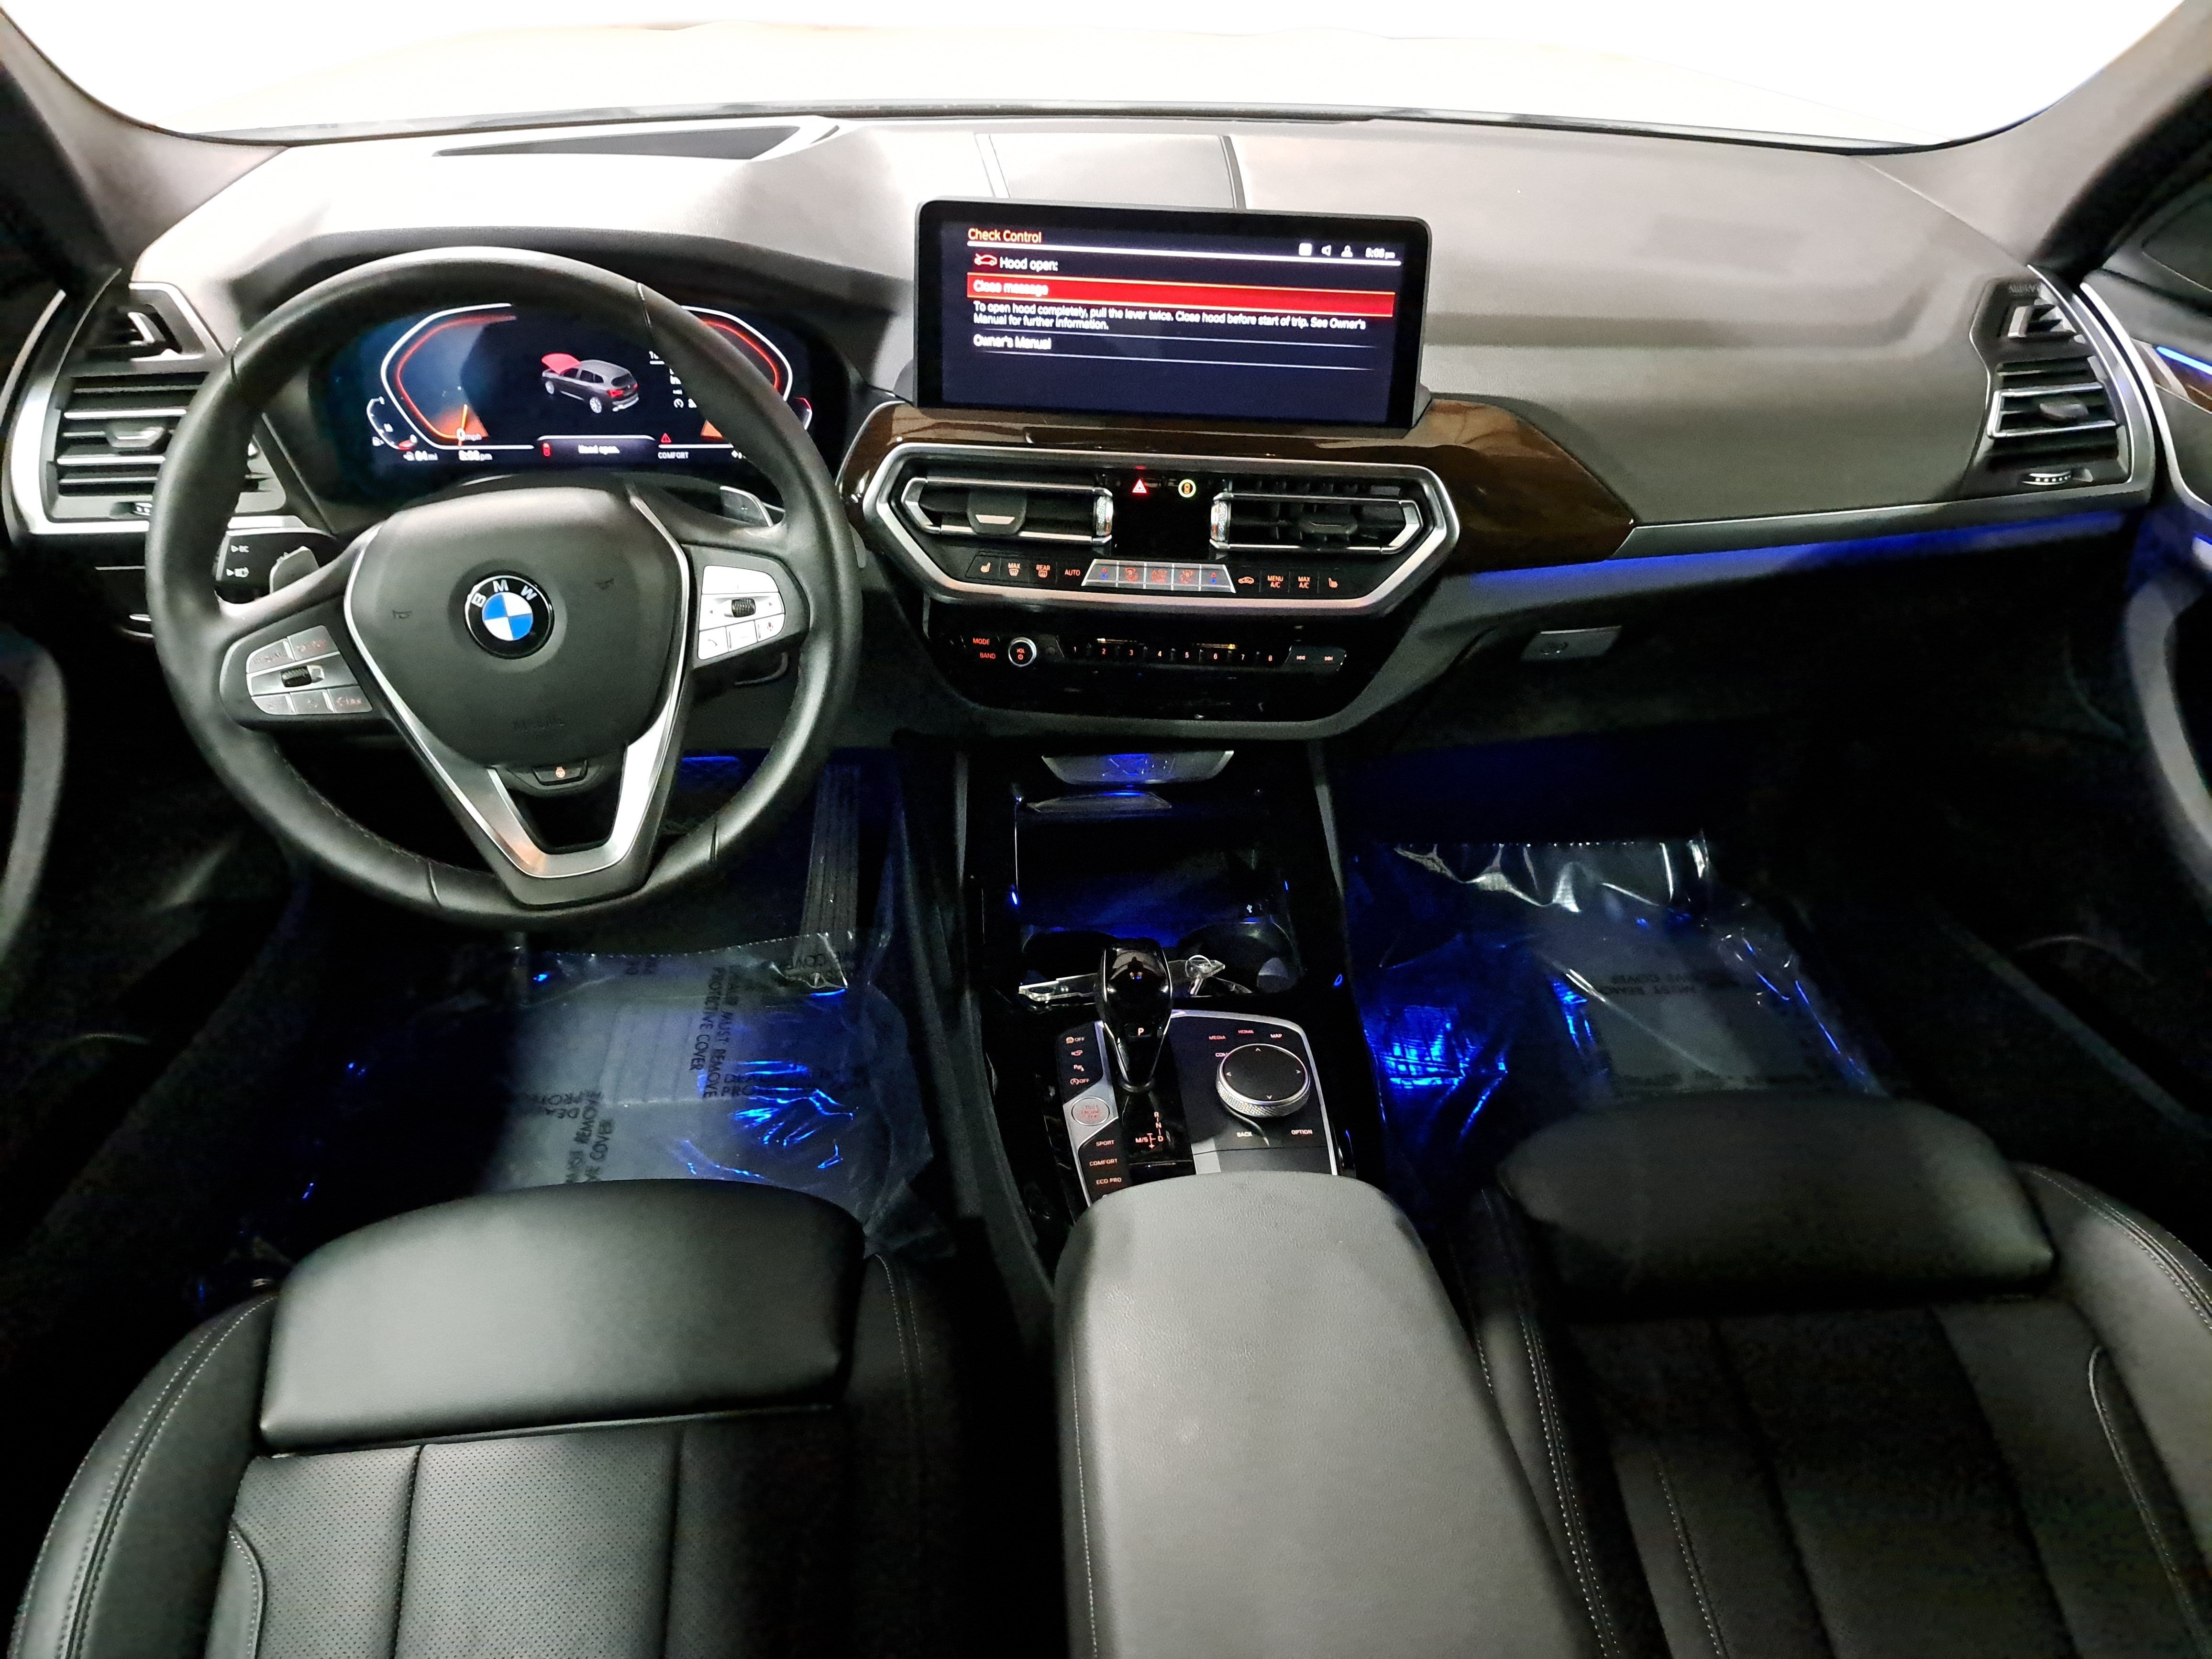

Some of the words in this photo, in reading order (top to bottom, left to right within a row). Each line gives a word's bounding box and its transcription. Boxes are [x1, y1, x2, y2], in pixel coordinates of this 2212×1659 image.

[968, 228, 1001, 241] Check
[1003, 230, 1041, 243] Control
[1000, 256, 1028, 269] Hood
[1029, 260, 1058, 272] open:
[973, 279, 1002, 293] Close
[1003, 283, 1049, 297] message
[973, 300, 986, 312] To
[987, 303, 1011, 314] open
[1012, 303, 1036, 314] hood
[1090, 307, 1106, 319] pull
[1108, 308, 1123, 319] the
[1125, 308, 1147, 320] lever
[1148, 310, 1173, 321] twice.
[1175, 311, 1200, 322] Close
[1202, 312, 1226, 324] hood
[1227, 313, 1257, 325] before
[1258, 315, 1279, 326] start
[1280, 315, 1291, 326] of
[1291, 316, 1309, 329] trip.
[1310, 317, 1328, 328] See
[1329, 318, 1366, 330] Owner's
[973, 313, 1006, 325] Manual
[1008, 314, 1022, 326] for
[1023, 315, 1054, 327] further
[973, 334, 1013, 348] Owner's
[1015, 336, 1051, 350] Manual
[471, 579, 537, 608] BMW
[1138, 1028, 1144, 1037] P
[689, 1034, 710, 1071] COVER
[703, 1049, 726, 1099] REMOVE
[1089, 1158, 1117, 1166] COMFORT
